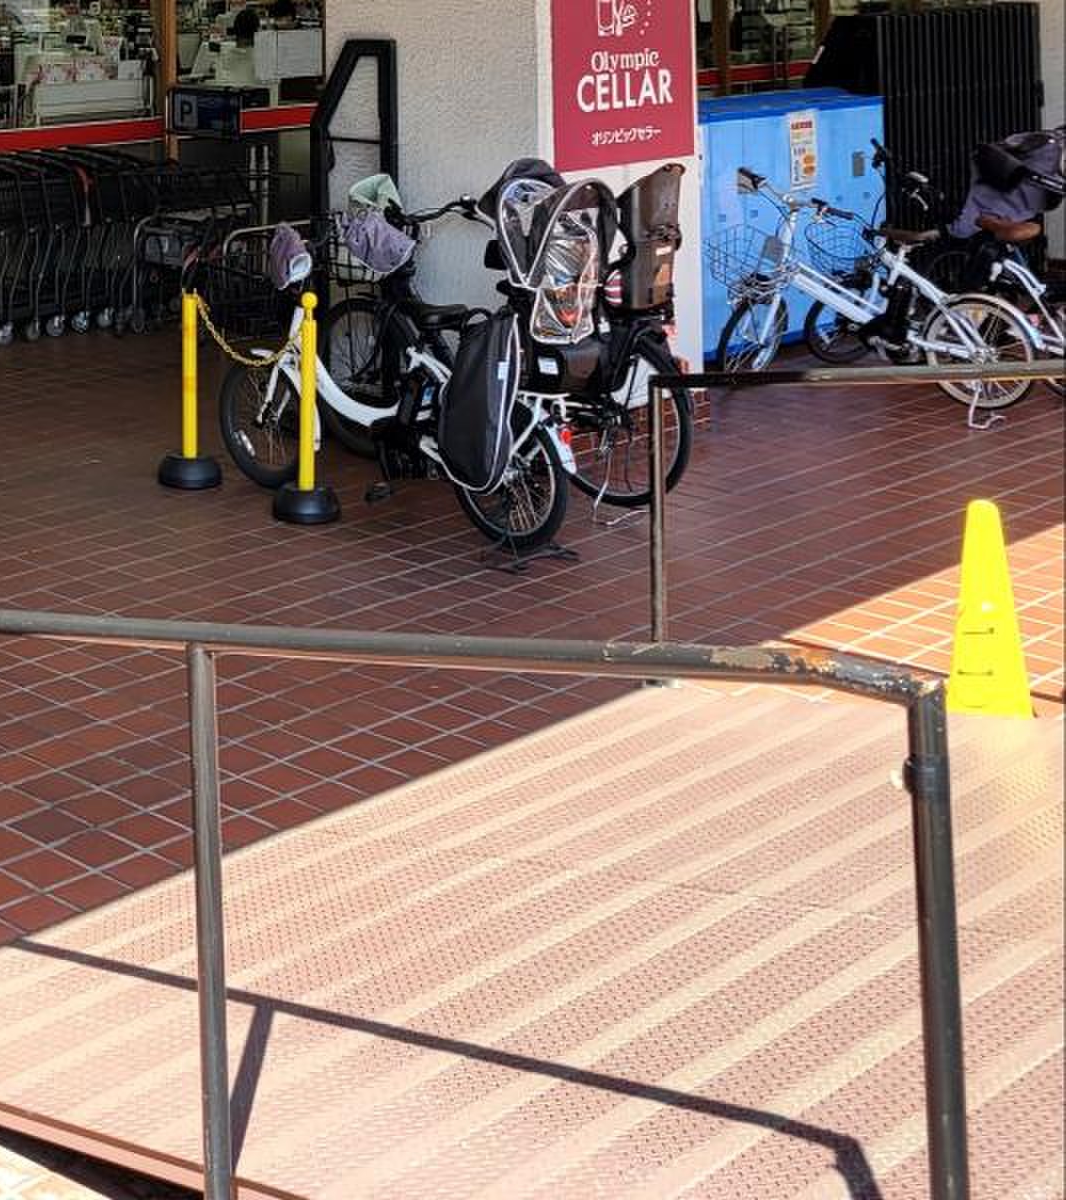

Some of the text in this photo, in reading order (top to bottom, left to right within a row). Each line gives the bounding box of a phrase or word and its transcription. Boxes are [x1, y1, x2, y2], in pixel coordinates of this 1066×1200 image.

[591, 48, 660, 74] Olympic
[576, 68, 673, 113] CELLAR
[591, 127, 662, 146] オリンピックセラー
